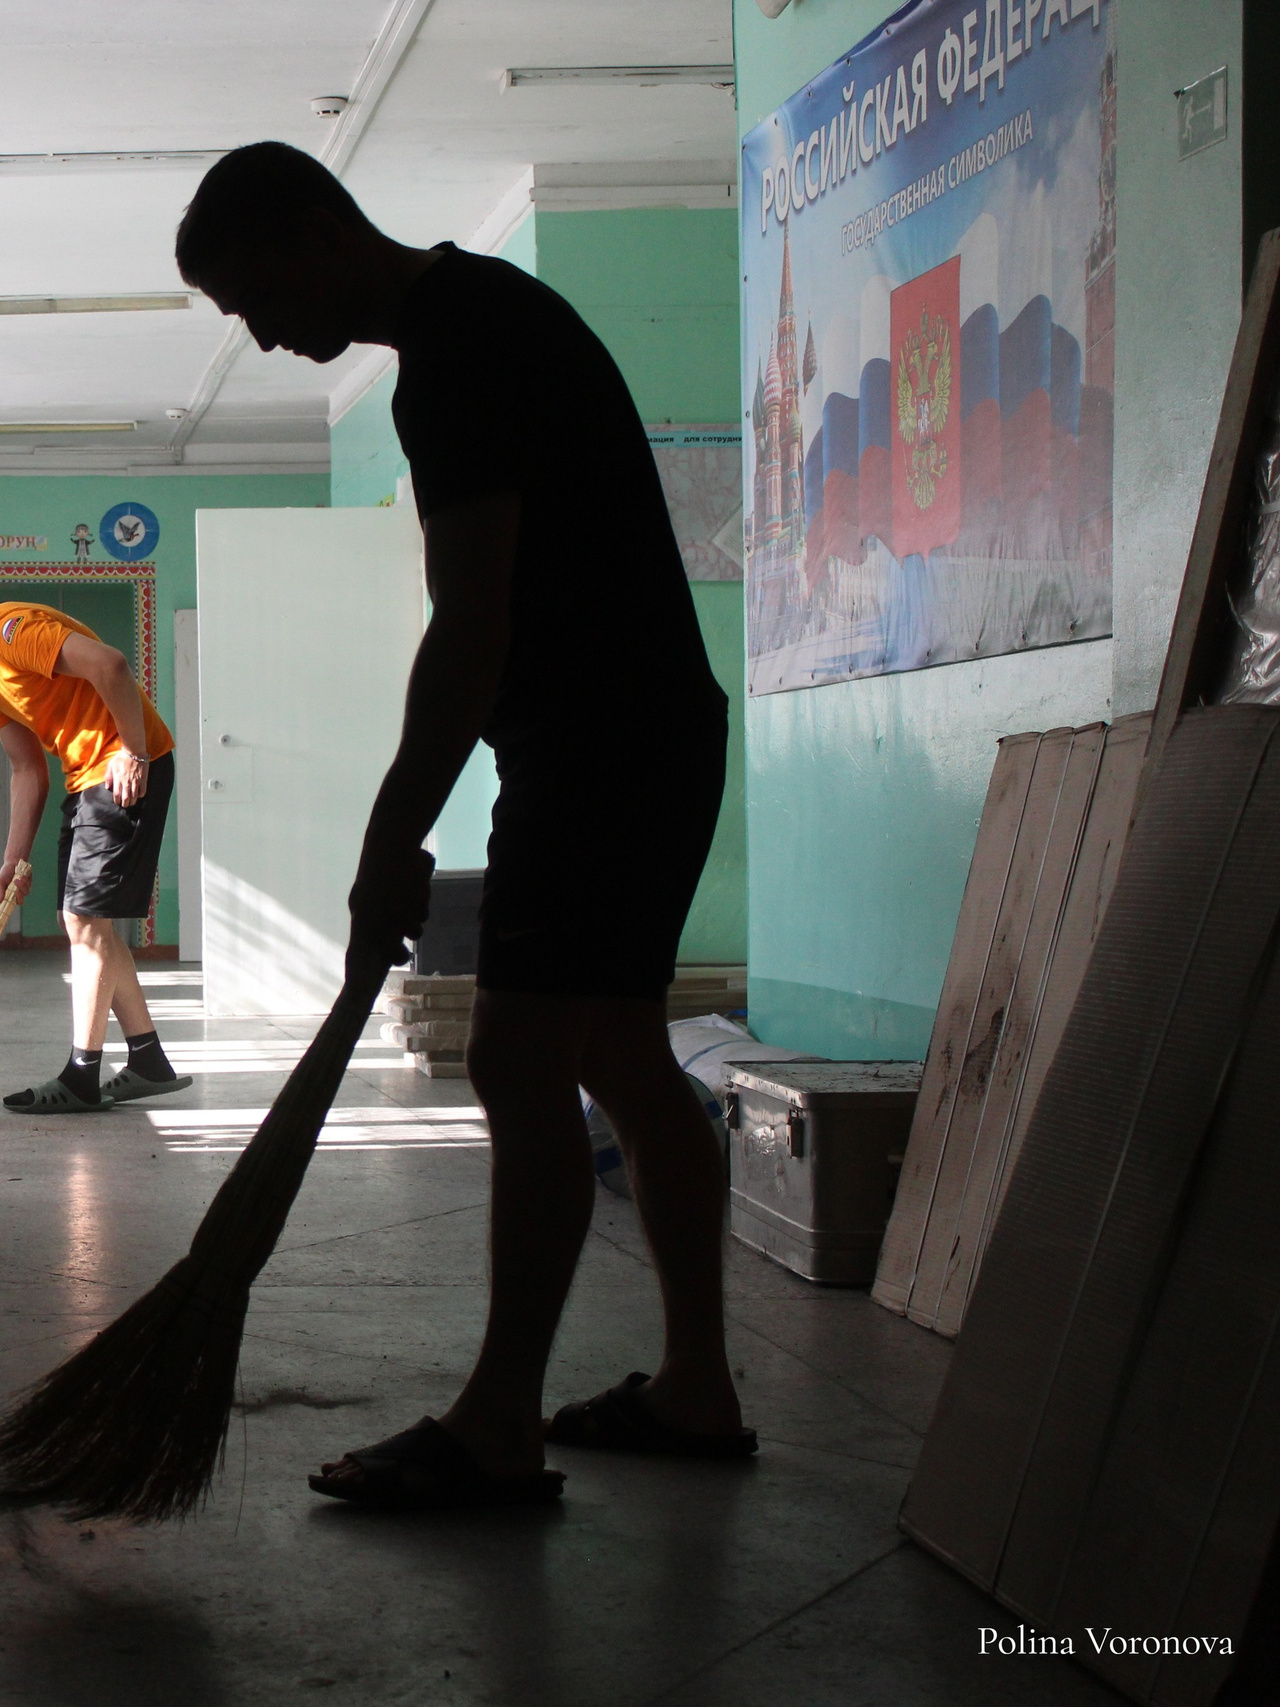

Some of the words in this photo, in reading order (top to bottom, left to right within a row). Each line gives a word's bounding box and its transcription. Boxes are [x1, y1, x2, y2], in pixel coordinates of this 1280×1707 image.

[761, 48, 927, 233] РОССИЙСКАЯ
[936, 0, 1101, 106] ФЕДЕР
[841, 164, 946, 257] ГОСУДАРСТВЕННАЯ
[947, 109, 1034, 190] СИМВОЛИКА
[683, 436, 700, 444] для
